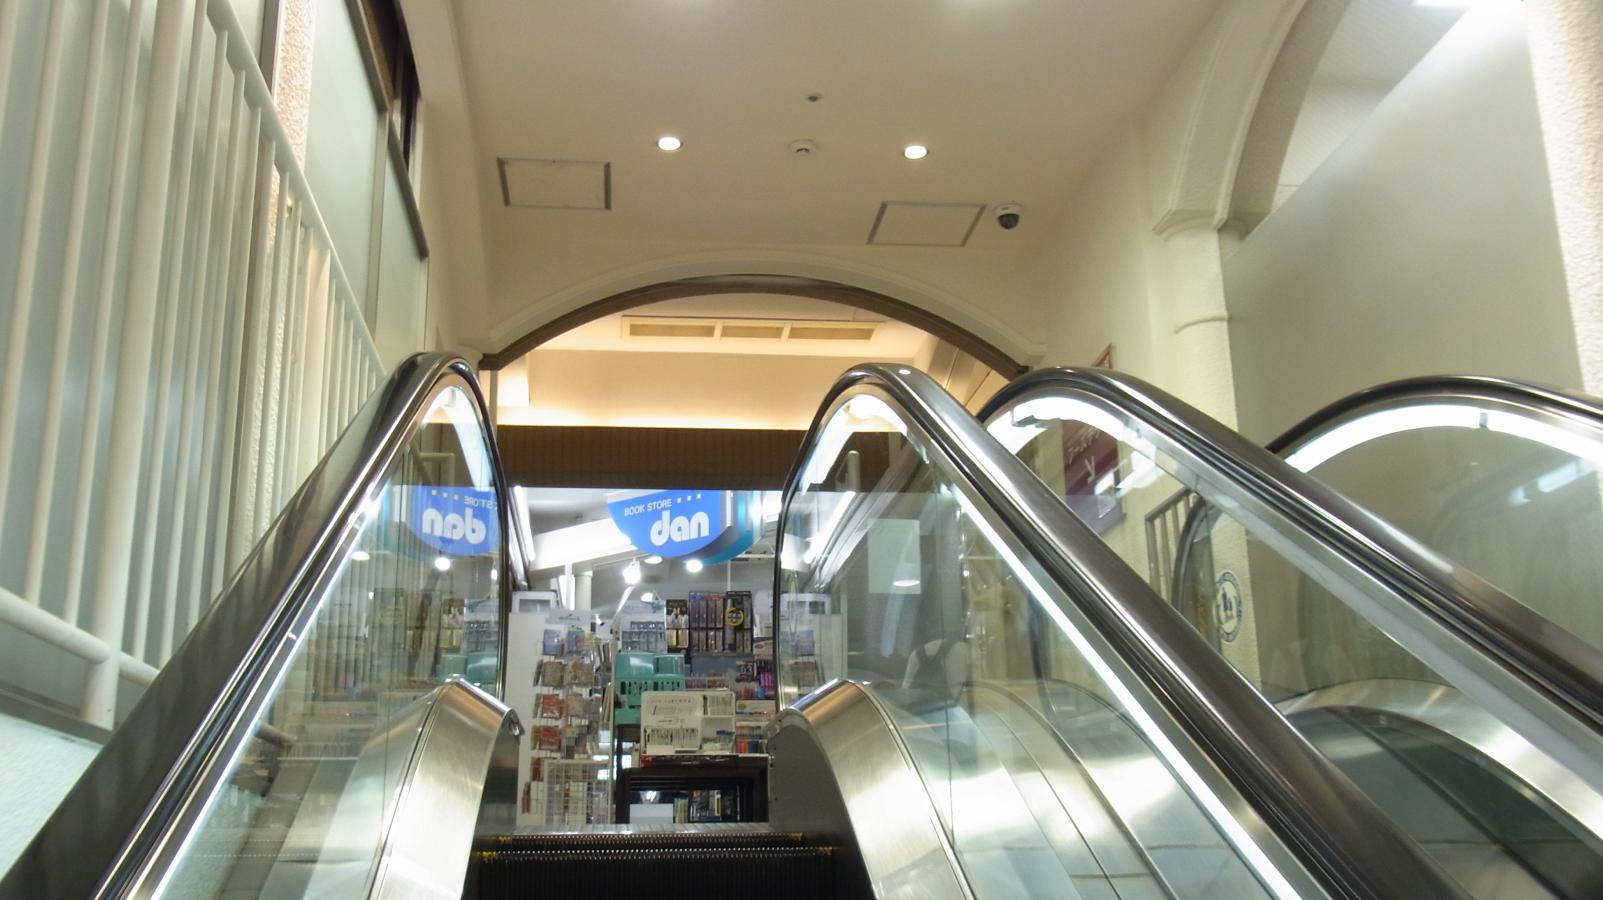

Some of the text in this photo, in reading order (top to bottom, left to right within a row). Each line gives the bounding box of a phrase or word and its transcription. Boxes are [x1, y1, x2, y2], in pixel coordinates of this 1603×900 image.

[624, 498, 672, 516] BOOK STORE
[650, 509, 709, 546] dan
